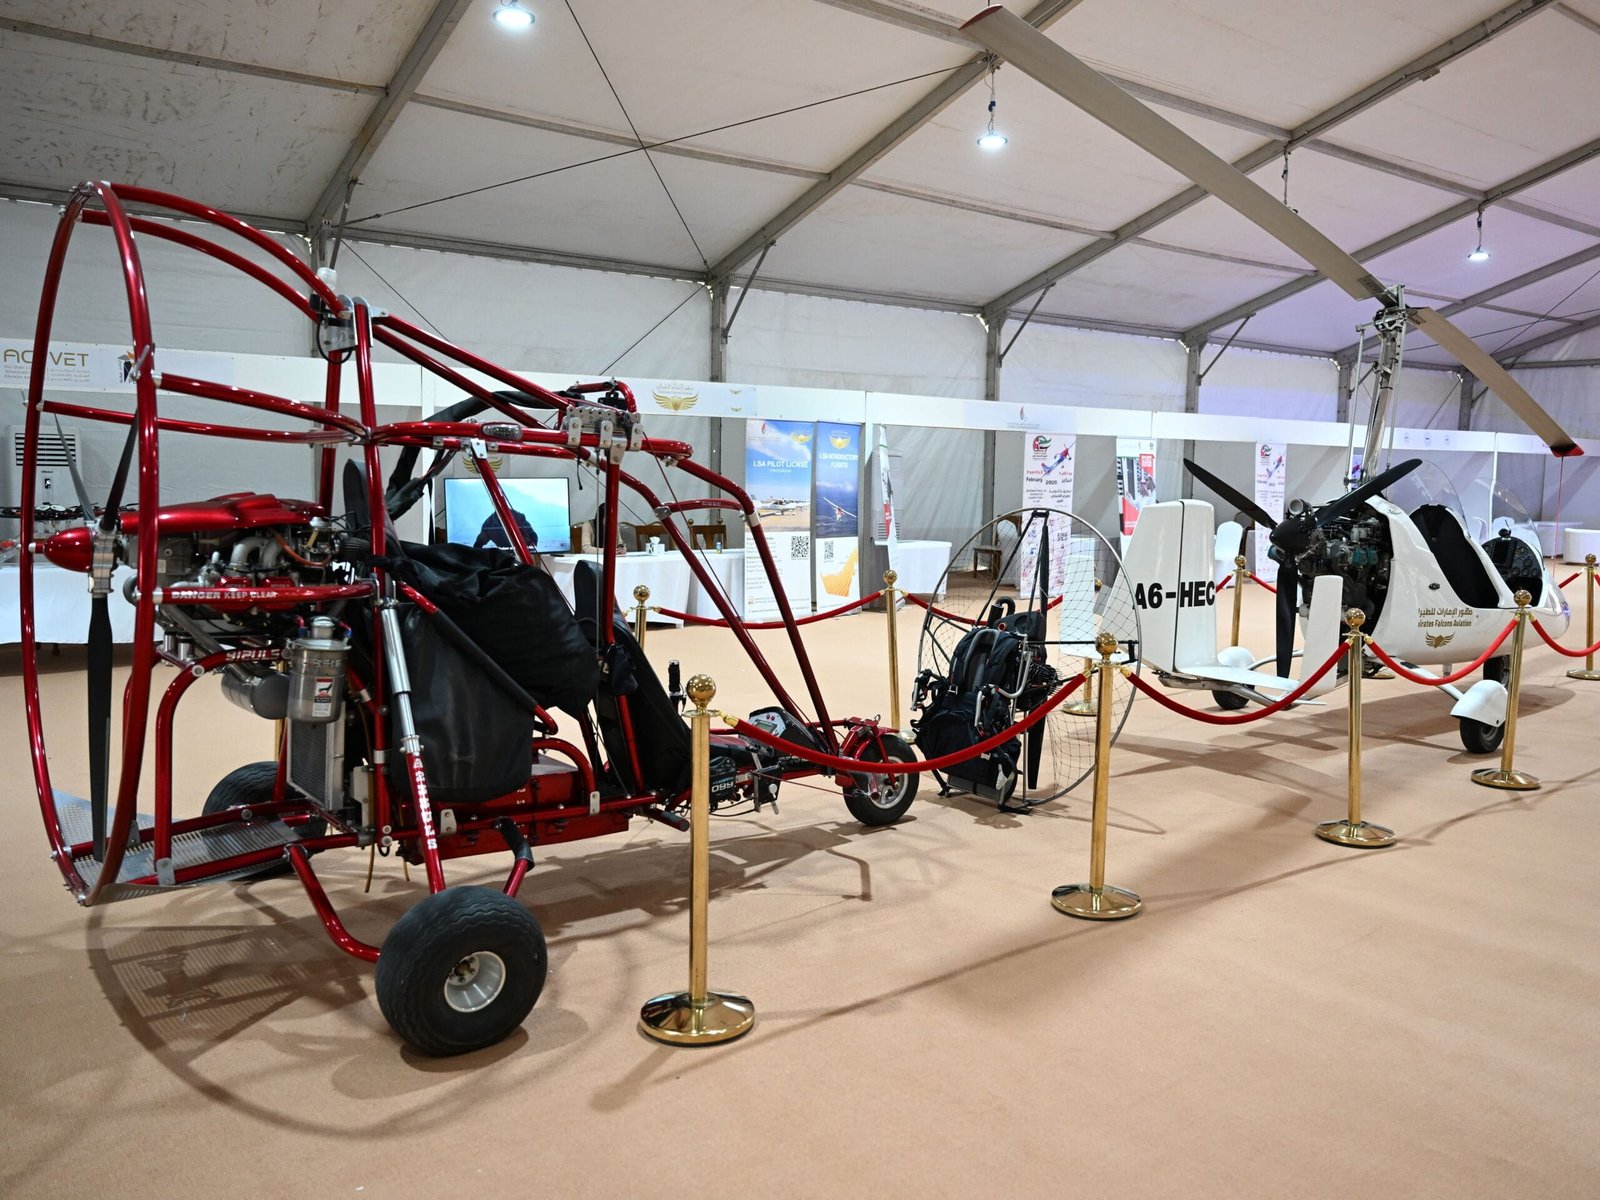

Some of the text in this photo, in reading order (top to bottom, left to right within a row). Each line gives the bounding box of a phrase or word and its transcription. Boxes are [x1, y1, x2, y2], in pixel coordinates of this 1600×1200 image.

[3, 348, 89, 367] ACVET
[767, 460, 785, 468] PILOT
[171, 591, 277, 599] DANGER KEEP CLEAR
[1132, 581, 1215, 609] A6-HEC
[1458, 607, 1473, 617] صقور
[1434, 619, 1453, 627] Falcons
[1453, 619, 1472, 627] Aviation
